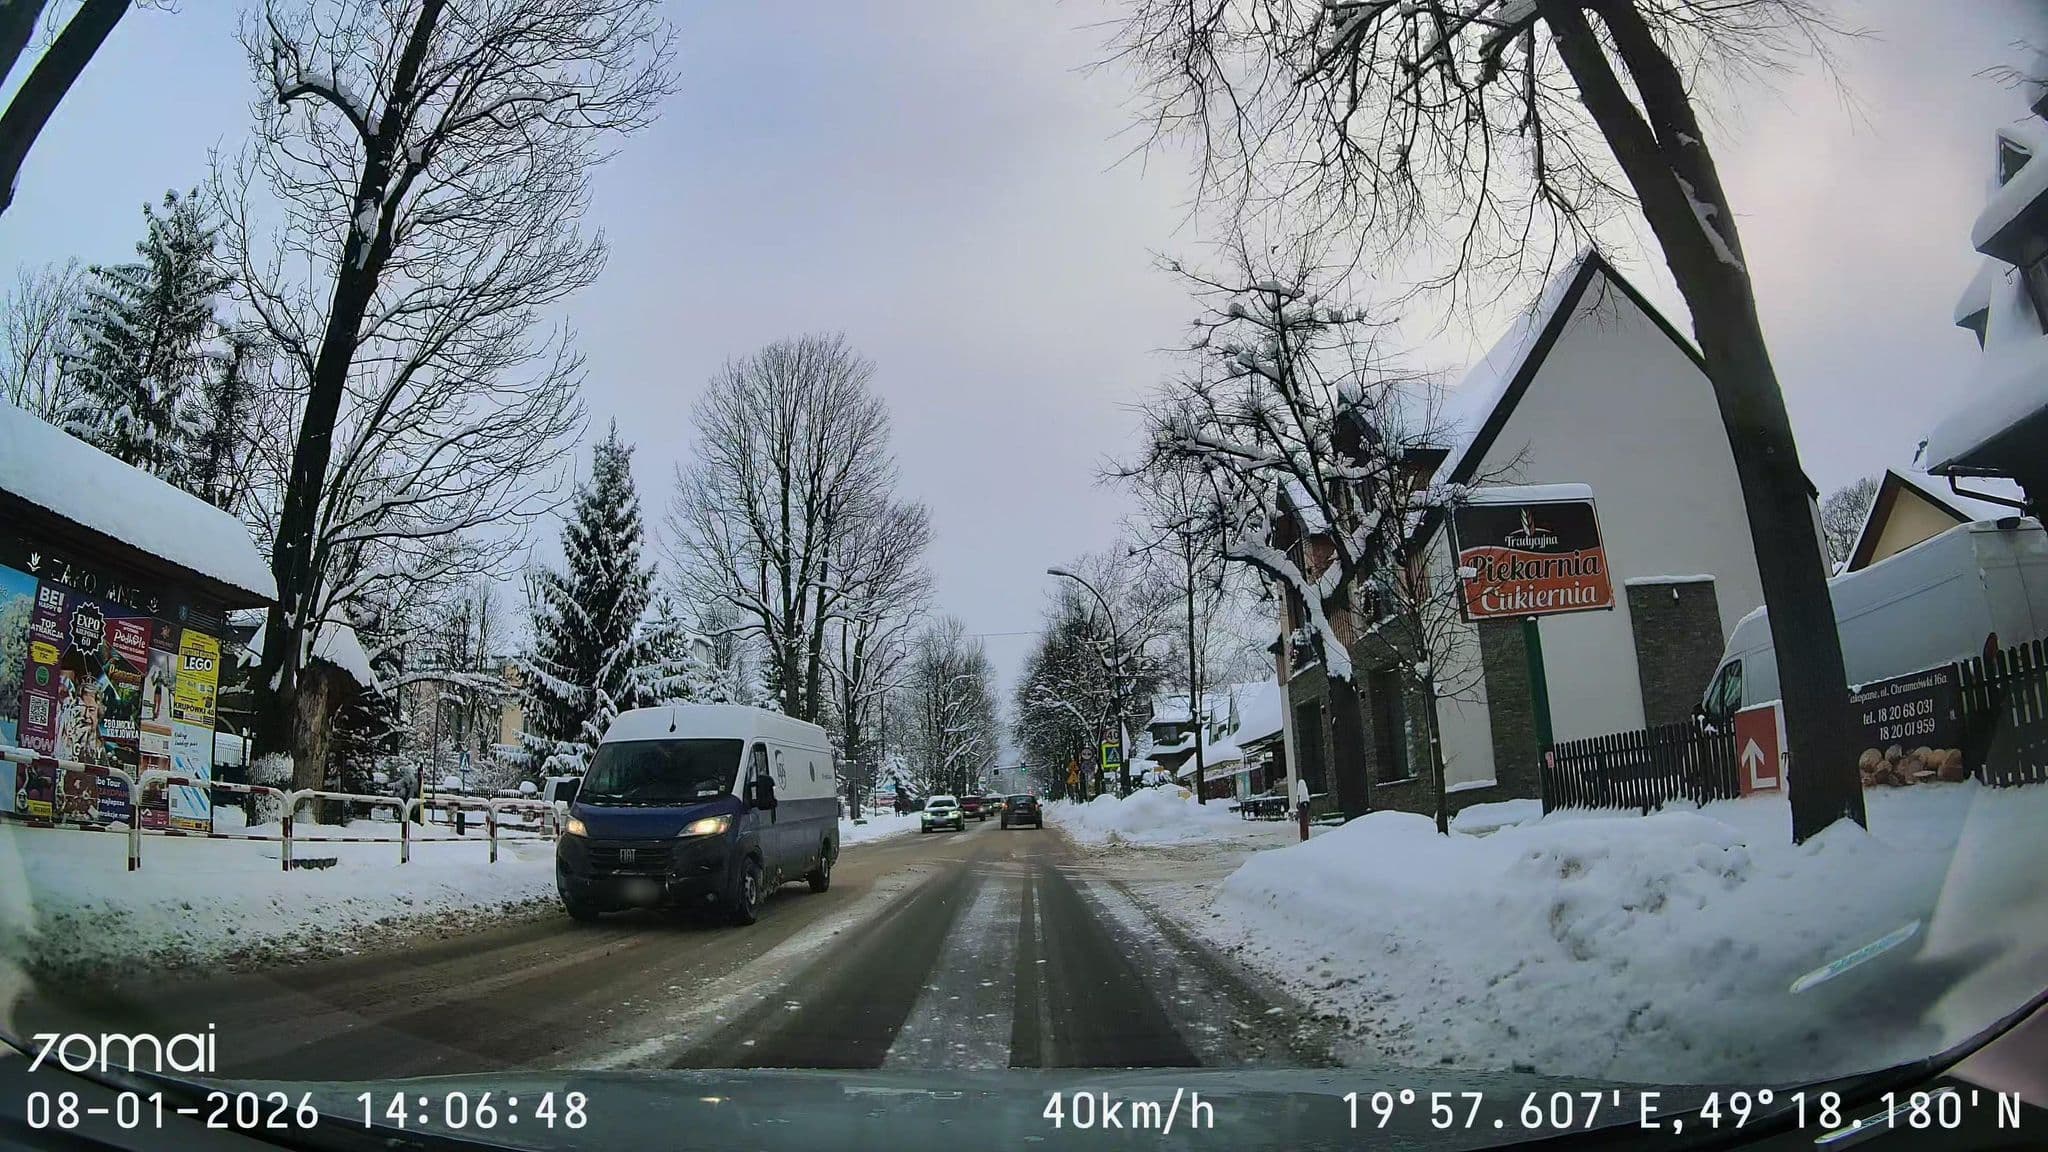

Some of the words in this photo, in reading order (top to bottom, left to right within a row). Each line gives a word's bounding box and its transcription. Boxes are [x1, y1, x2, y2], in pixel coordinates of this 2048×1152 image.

[1504, 533, 1559, 549] Tradycyjna
[1466, 550, 1603, 585] Piekarnia
[1480, 580, 1597, 613] Cukiernia
[76, 613, 101, 631] EXPO
[183, 655, 213, 671] LEGO
[1863, 711, 1877, 725] tel.
[1878, 708, 1888, 722] 18
[1889, 705, 1901, 720] 20
[1903, 702, 1915, 718] 68
[1916, 698, 1933, 715] 031
[1880, 726, 1890, 740] 18
[1891, 723, 1903, 739] 20
[1904, 721, 1915, 736] 01
[1916, 717, 1935, 734] 959
[620, 848, 637, 864] FIAT
